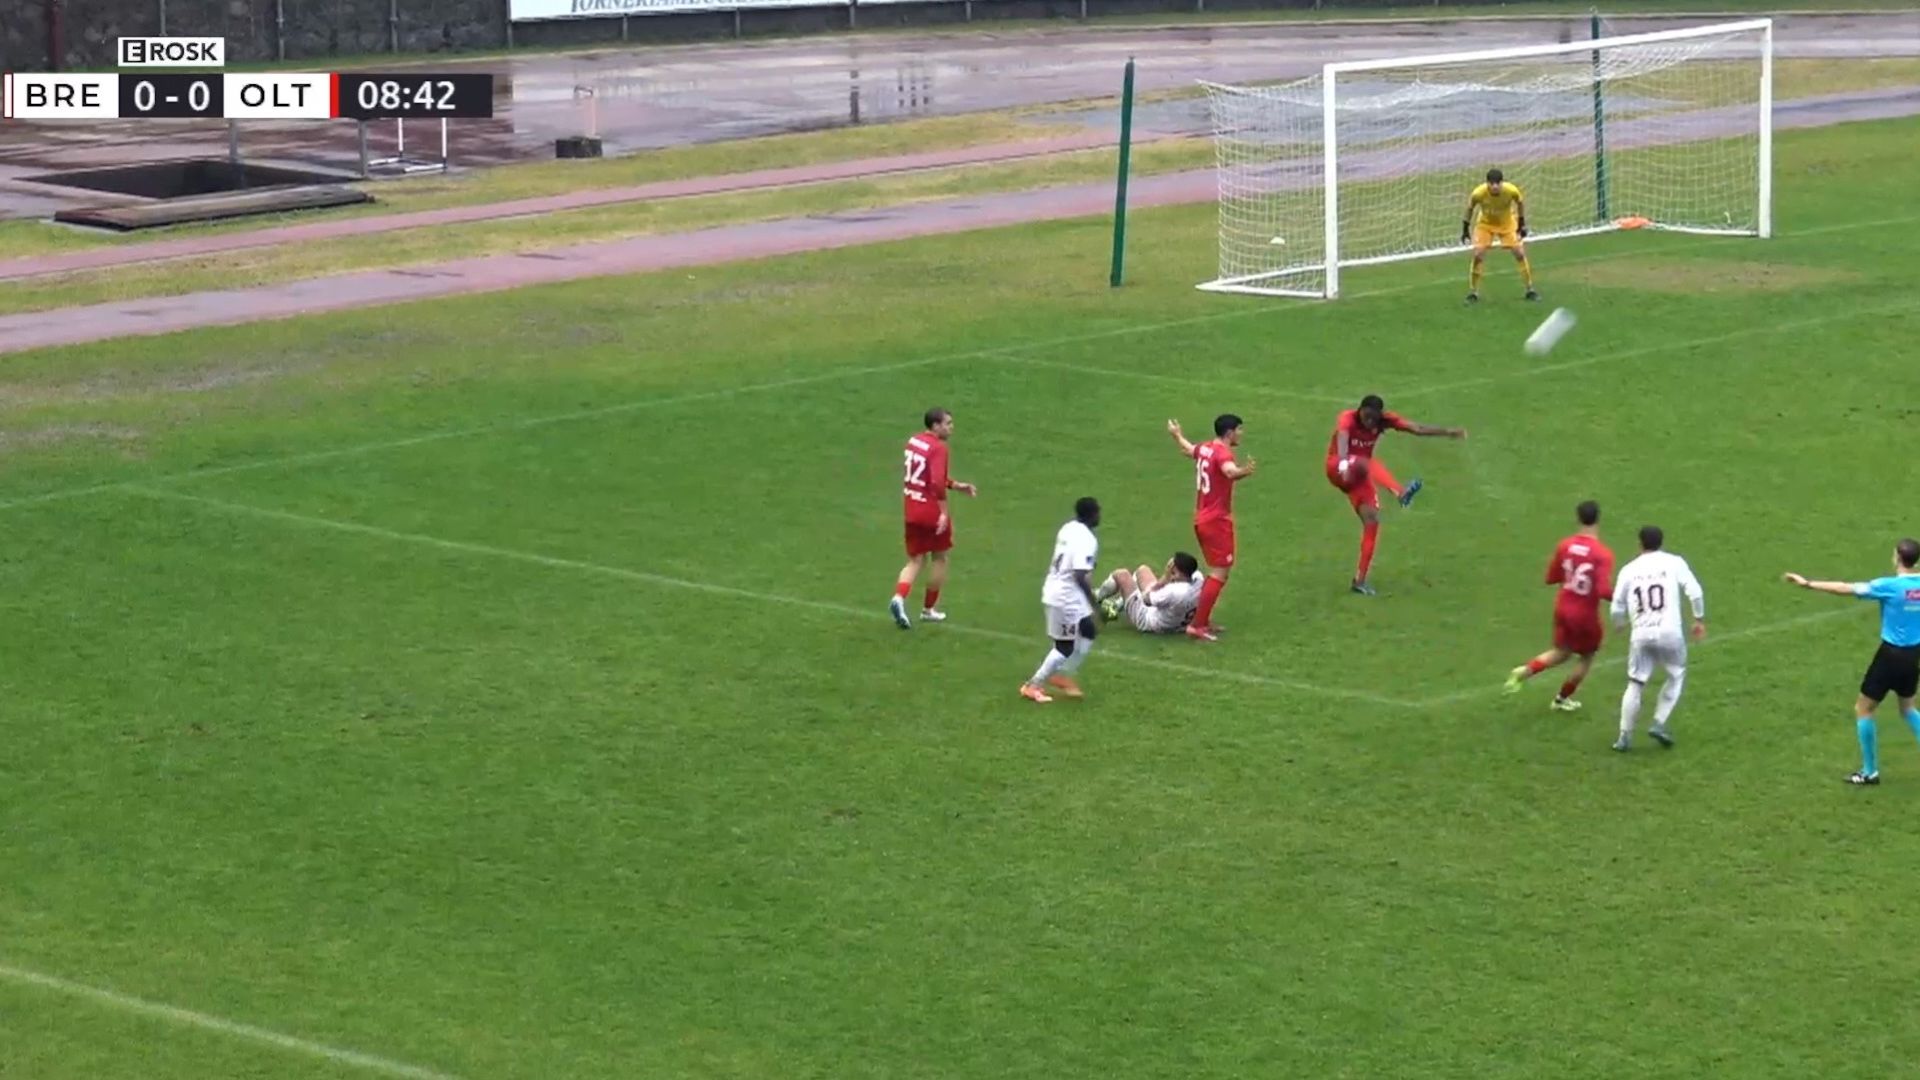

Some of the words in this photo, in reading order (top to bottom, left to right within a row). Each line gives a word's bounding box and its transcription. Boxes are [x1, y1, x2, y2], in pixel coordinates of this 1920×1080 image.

[1196, 457, 1211, 495] 15
[1561, 558, 1594, 596] 16
[1633, 584, 1665, 614] 10
[1060, 624, 1076, 637] 14
